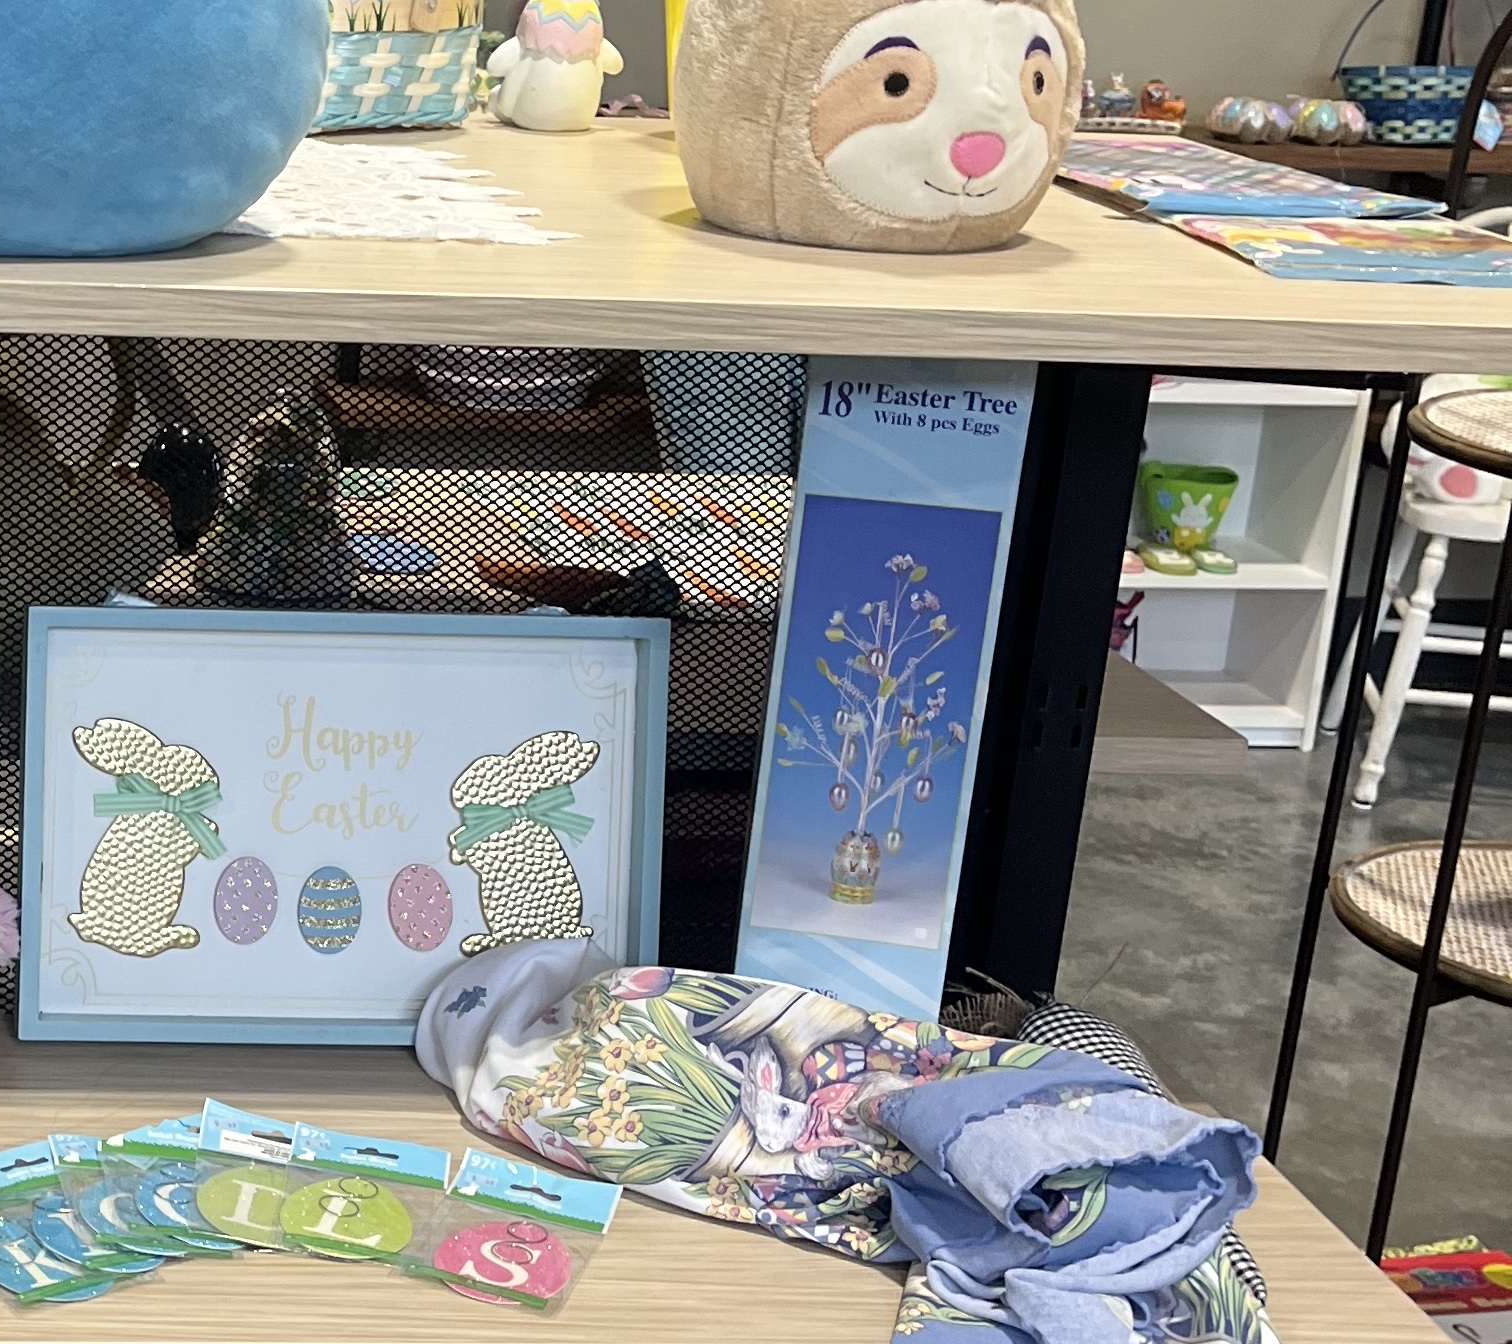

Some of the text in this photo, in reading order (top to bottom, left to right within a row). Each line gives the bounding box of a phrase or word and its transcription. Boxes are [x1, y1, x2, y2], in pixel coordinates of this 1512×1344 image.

[818, 380, 1018, 418] 18" Easter Tree
[874, 410, 1001, 436] With 8 pcs Eggs
[266, 692, 424, 772] Happy
[263, 770, 420, 840] Easter
[459, 1240, 542, 1288] S
